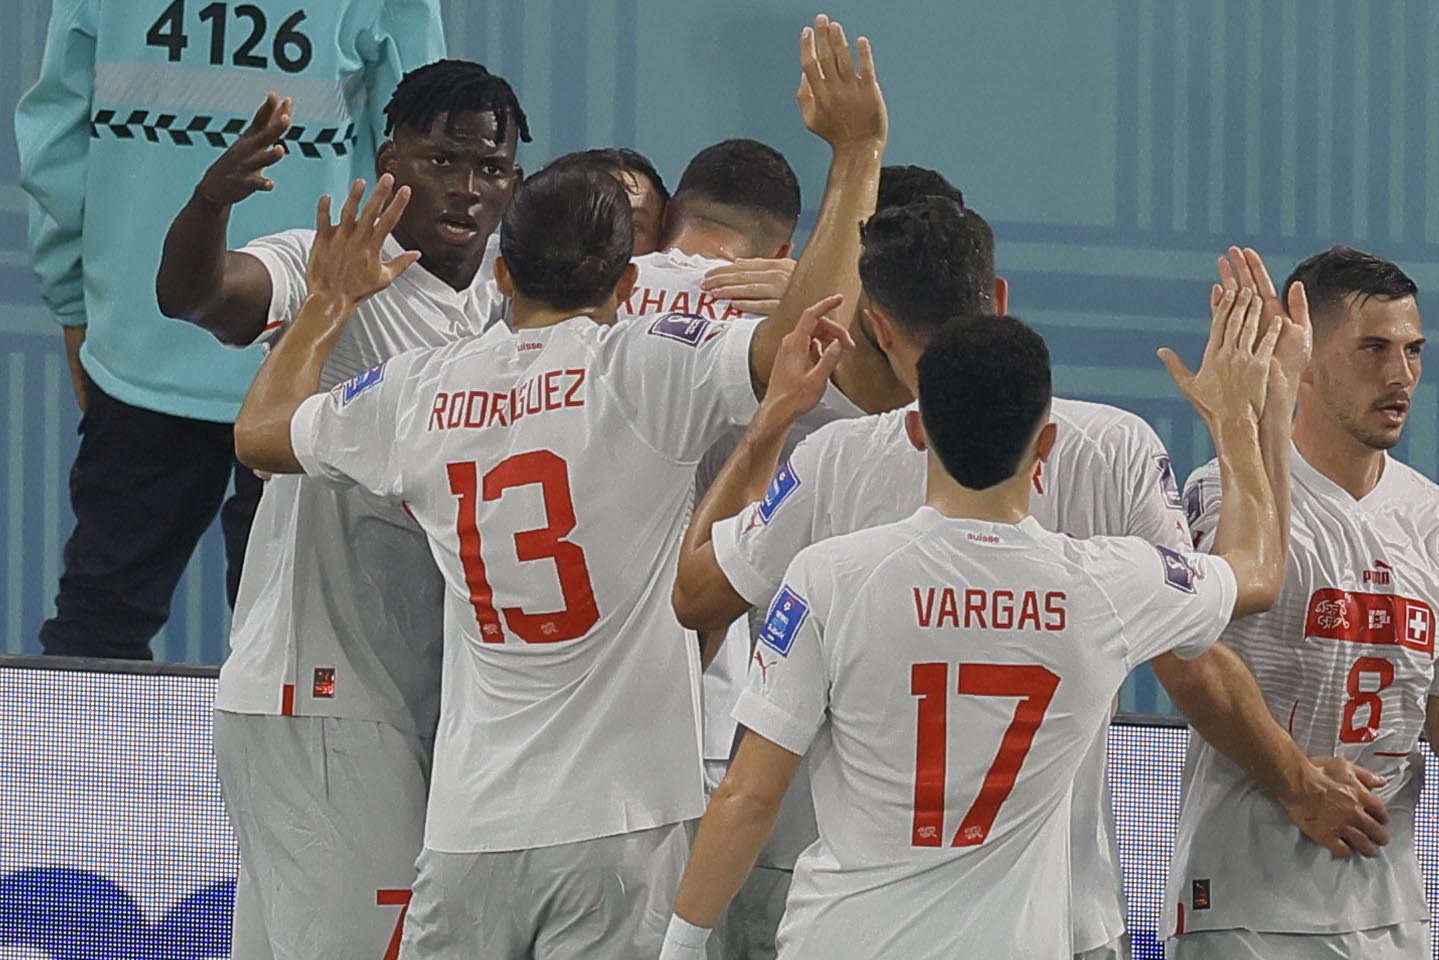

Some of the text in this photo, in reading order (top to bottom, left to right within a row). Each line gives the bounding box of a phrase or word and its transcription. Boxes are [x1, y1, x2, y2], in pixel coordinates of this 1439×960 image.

[146, 0, 312, 73] 4126
[447, 449, 601, 645] 13
[913, 587, 1067, 632] VARGAS
[1339, 656, 1396, 744] 8
[911, 662, 1061, 848] 17
